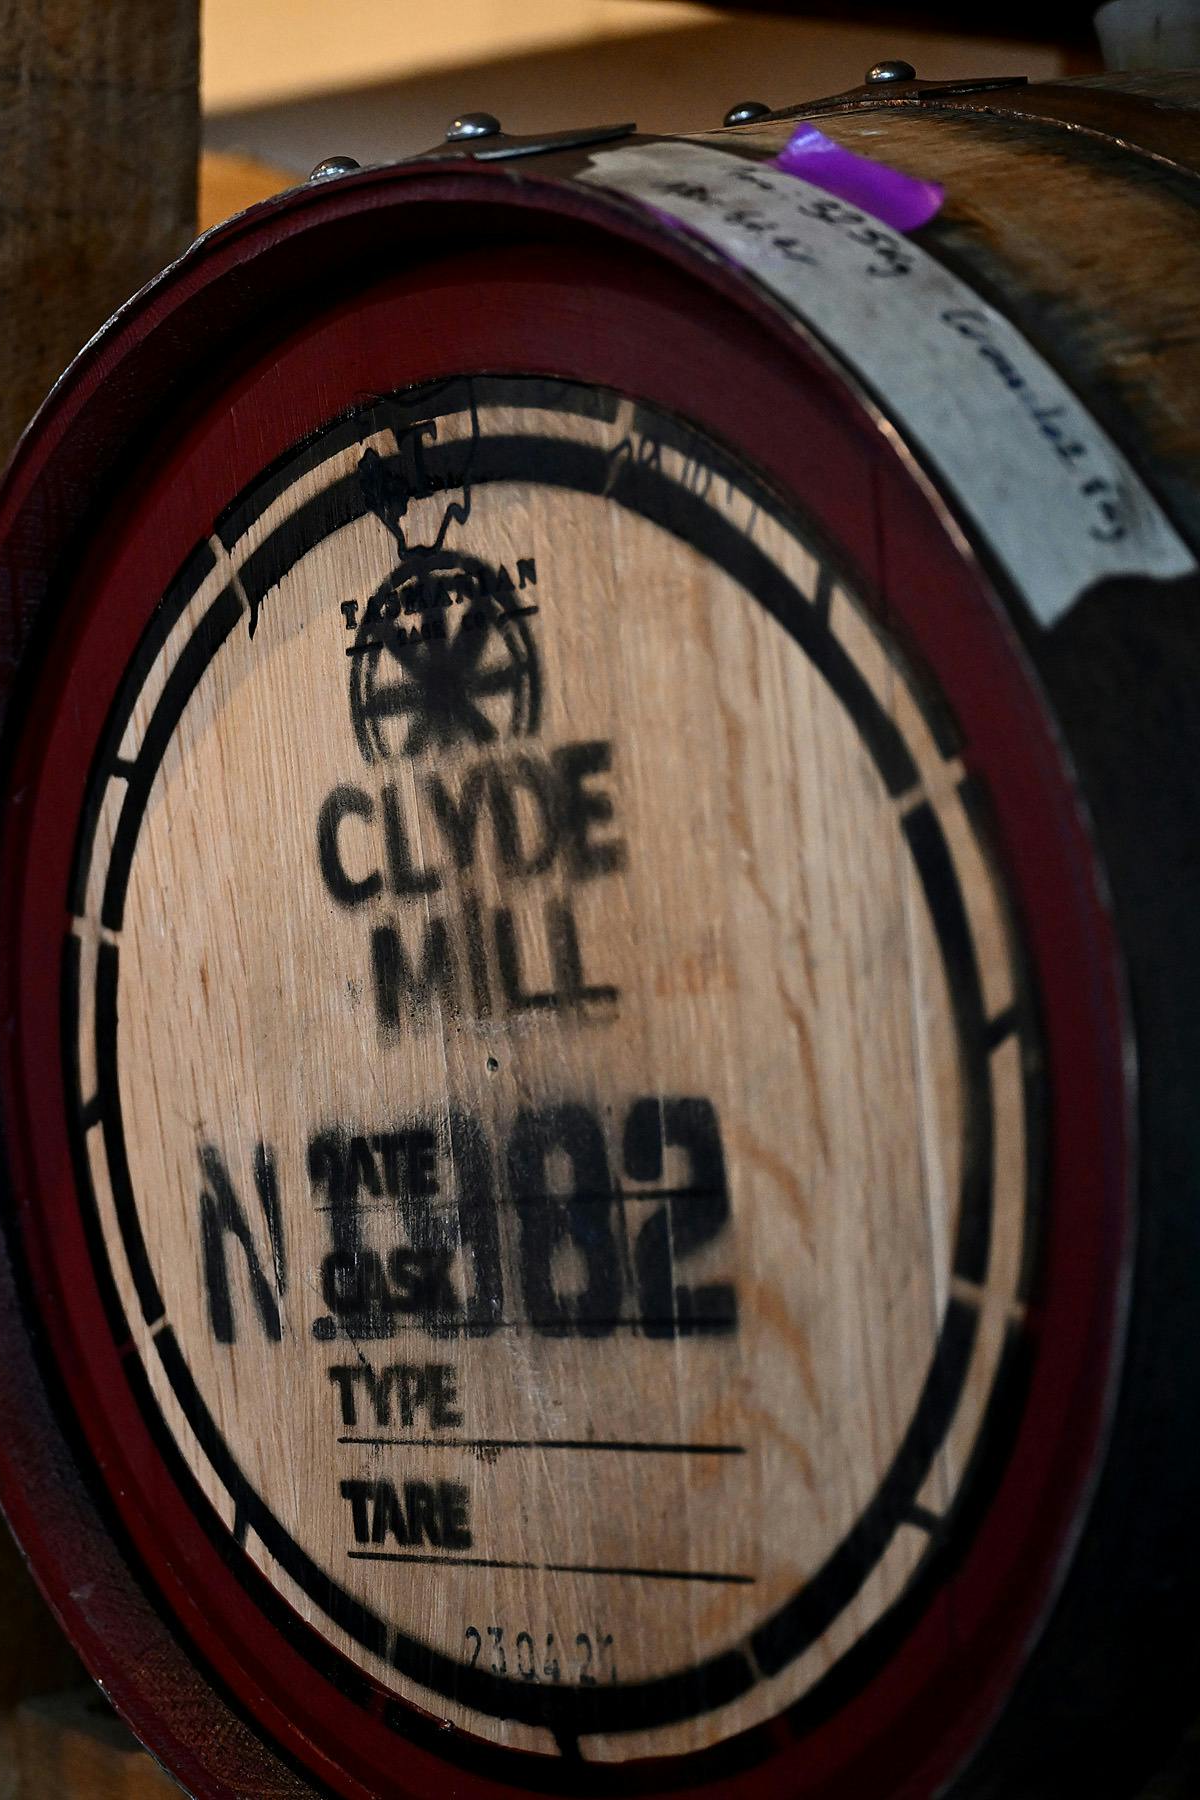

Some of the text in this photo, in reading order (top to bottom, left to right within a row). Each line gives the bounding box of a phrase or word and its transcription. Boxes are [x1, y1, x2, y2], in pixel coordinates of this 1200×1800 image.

[315, 739, 624, 907] CLYDE
[371, 891, 619, 1034] MILL
[329, 1365, 464, 1428] TYPE
[340, 1479, 472, 1550] TARE
